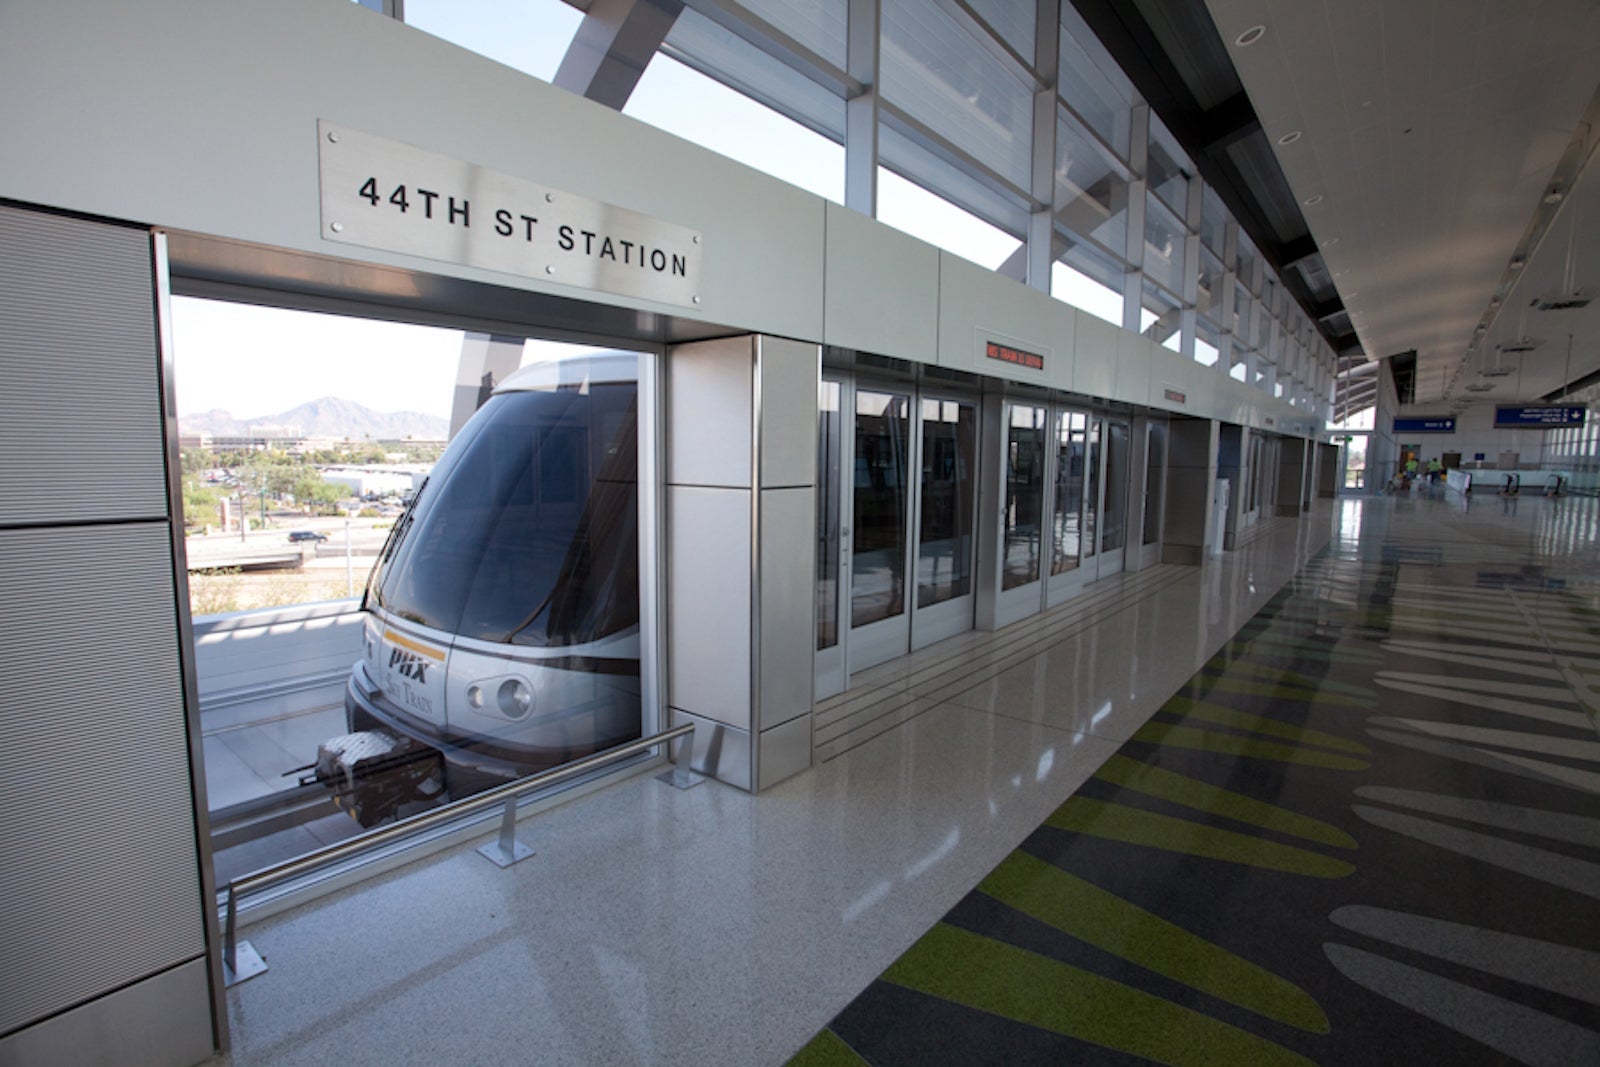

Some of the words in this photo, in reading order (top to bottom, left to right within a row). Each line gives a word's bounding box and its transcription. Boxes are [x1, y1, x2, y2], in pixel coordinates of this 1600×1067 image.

[358, 177, 470, 228] 44TH
[494, 209, 538, 242] ST
[557, 225, 686, 277] STATION
[388, 647, 430, 684] PHX
